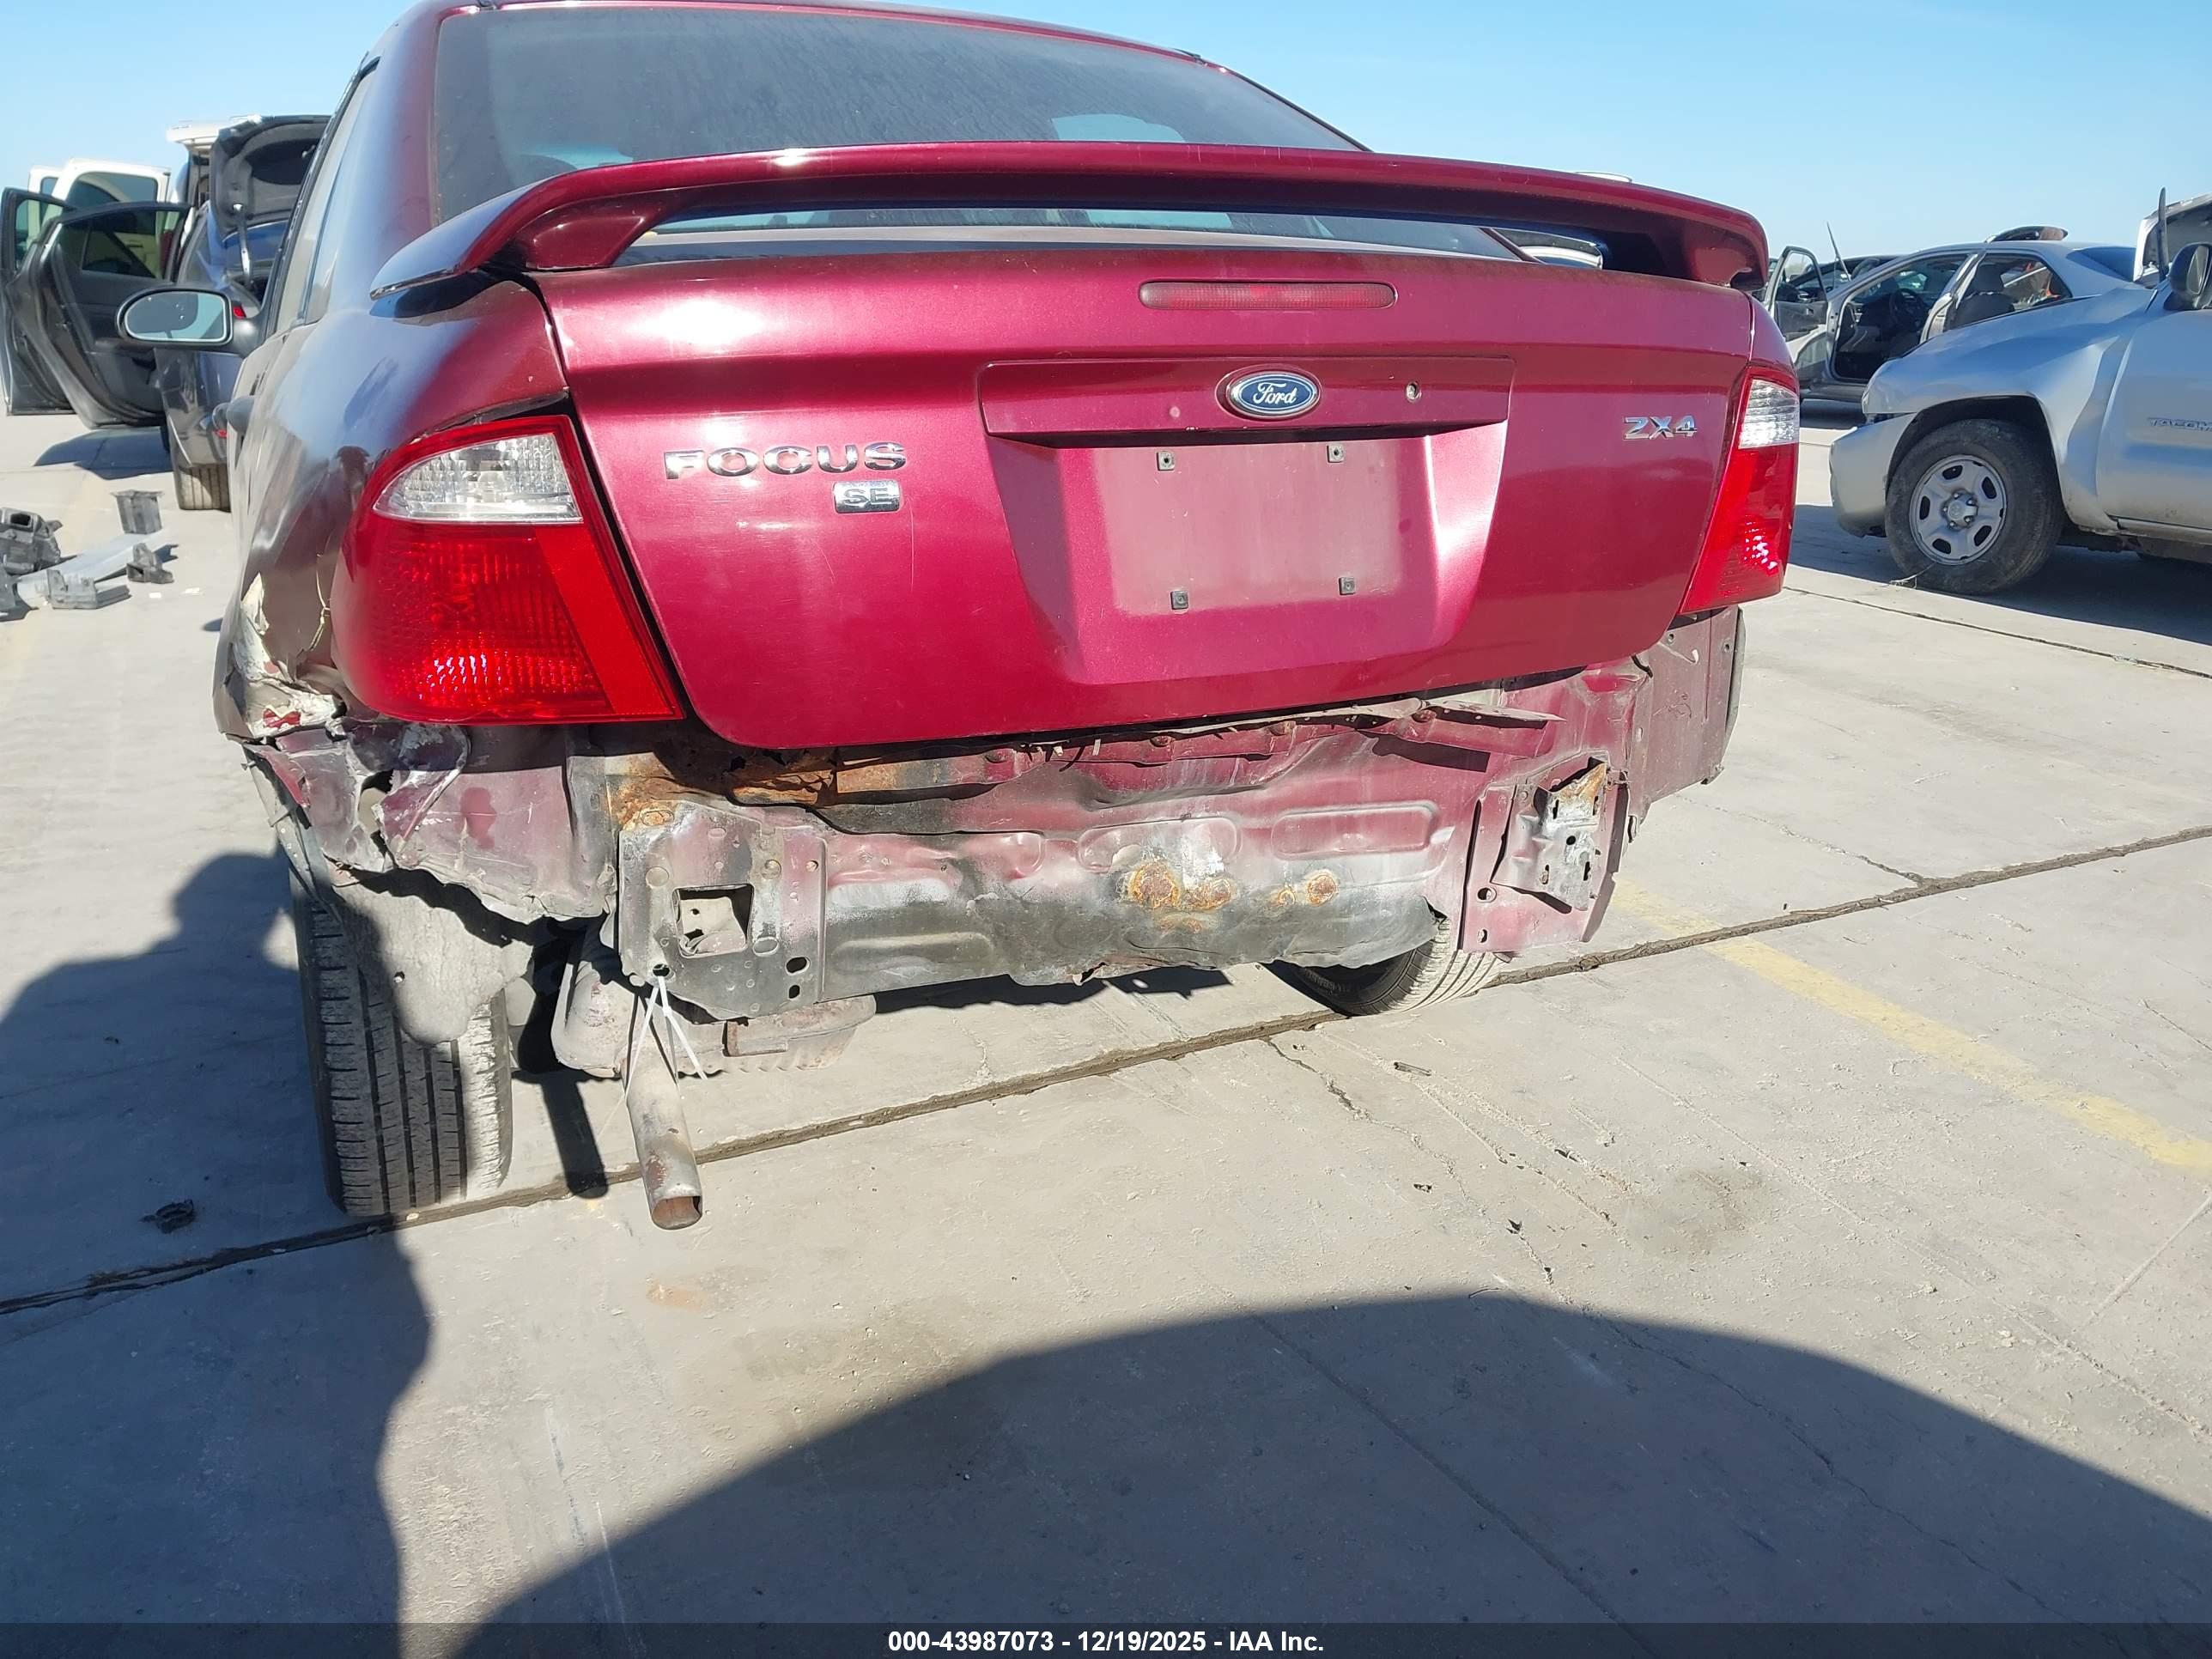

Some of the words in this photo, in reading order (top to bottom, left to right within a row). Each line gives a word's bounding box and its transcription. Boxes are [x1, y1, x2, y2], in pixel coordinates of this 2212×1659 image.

[1253, 381, 1297, 404] Ford
[1623, 416, 1697, 440] ZX4
[665, 441, 908, 480] FOCUS
[843, 487, 893, 507] SE
